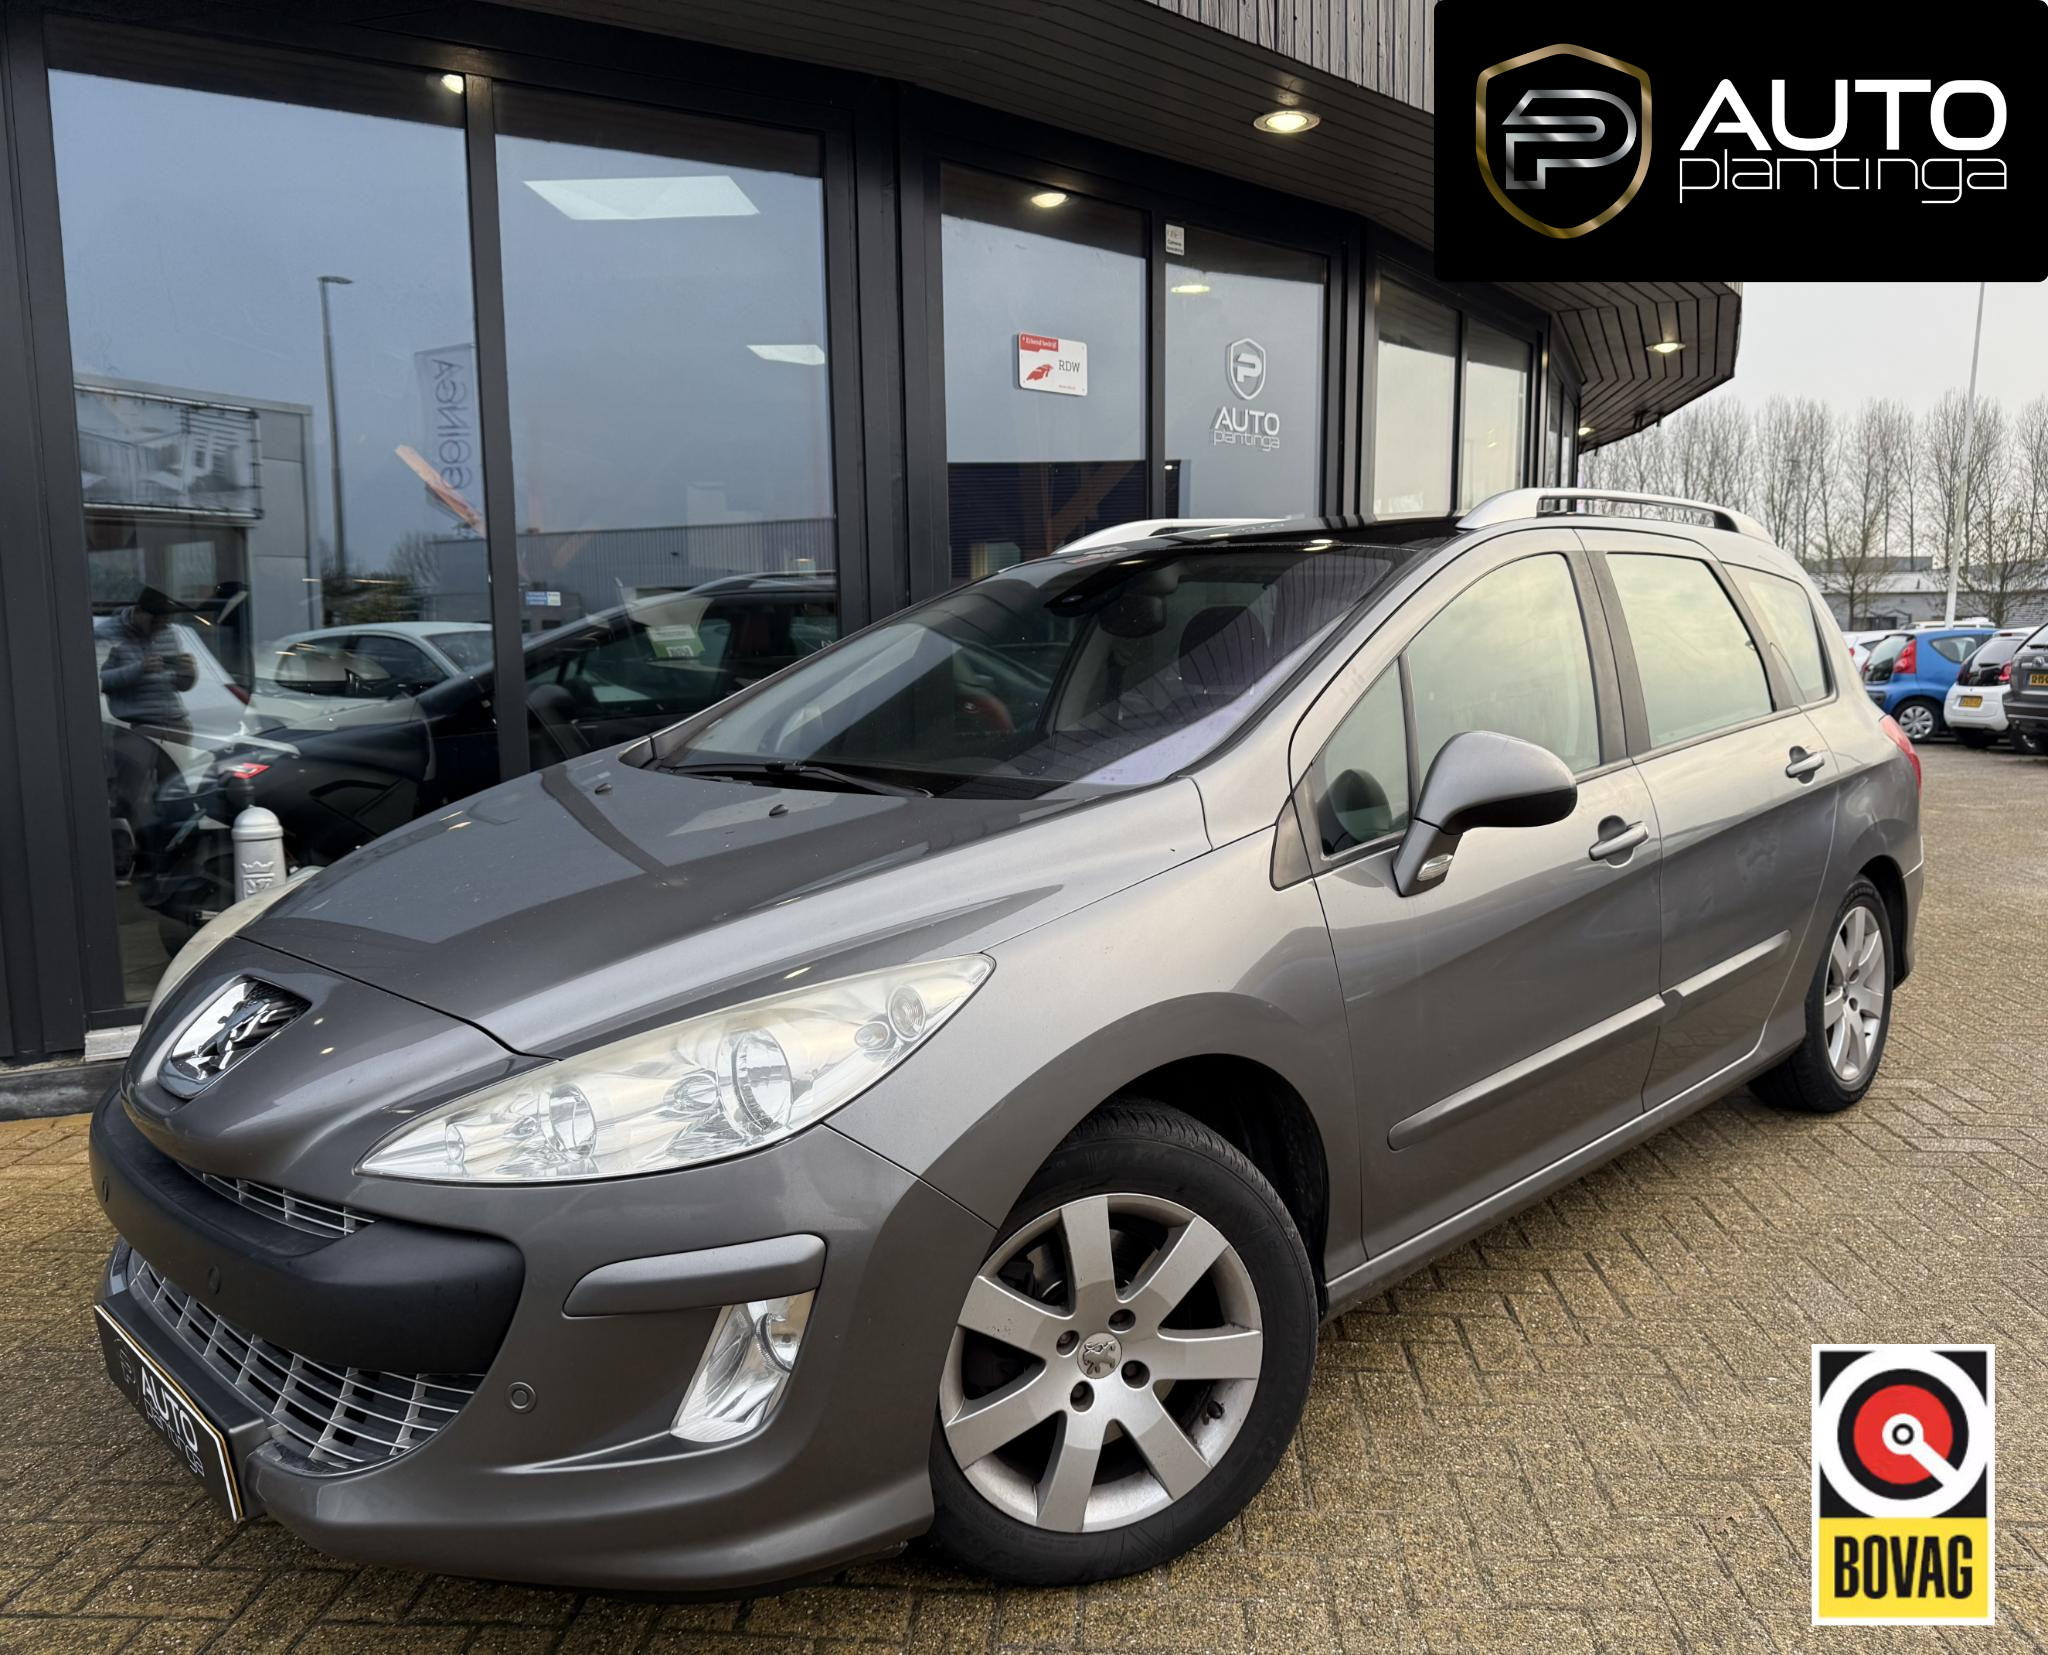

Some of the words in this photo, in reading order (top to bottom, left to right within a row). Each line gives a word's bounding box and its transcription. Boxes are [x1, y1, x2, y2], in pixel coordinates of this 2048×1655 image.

[1058, 359, 1081, 373] RDW
[1214, 406, 1281, 436] AUTO
[141, 1365, 198, 1453] AUTO
